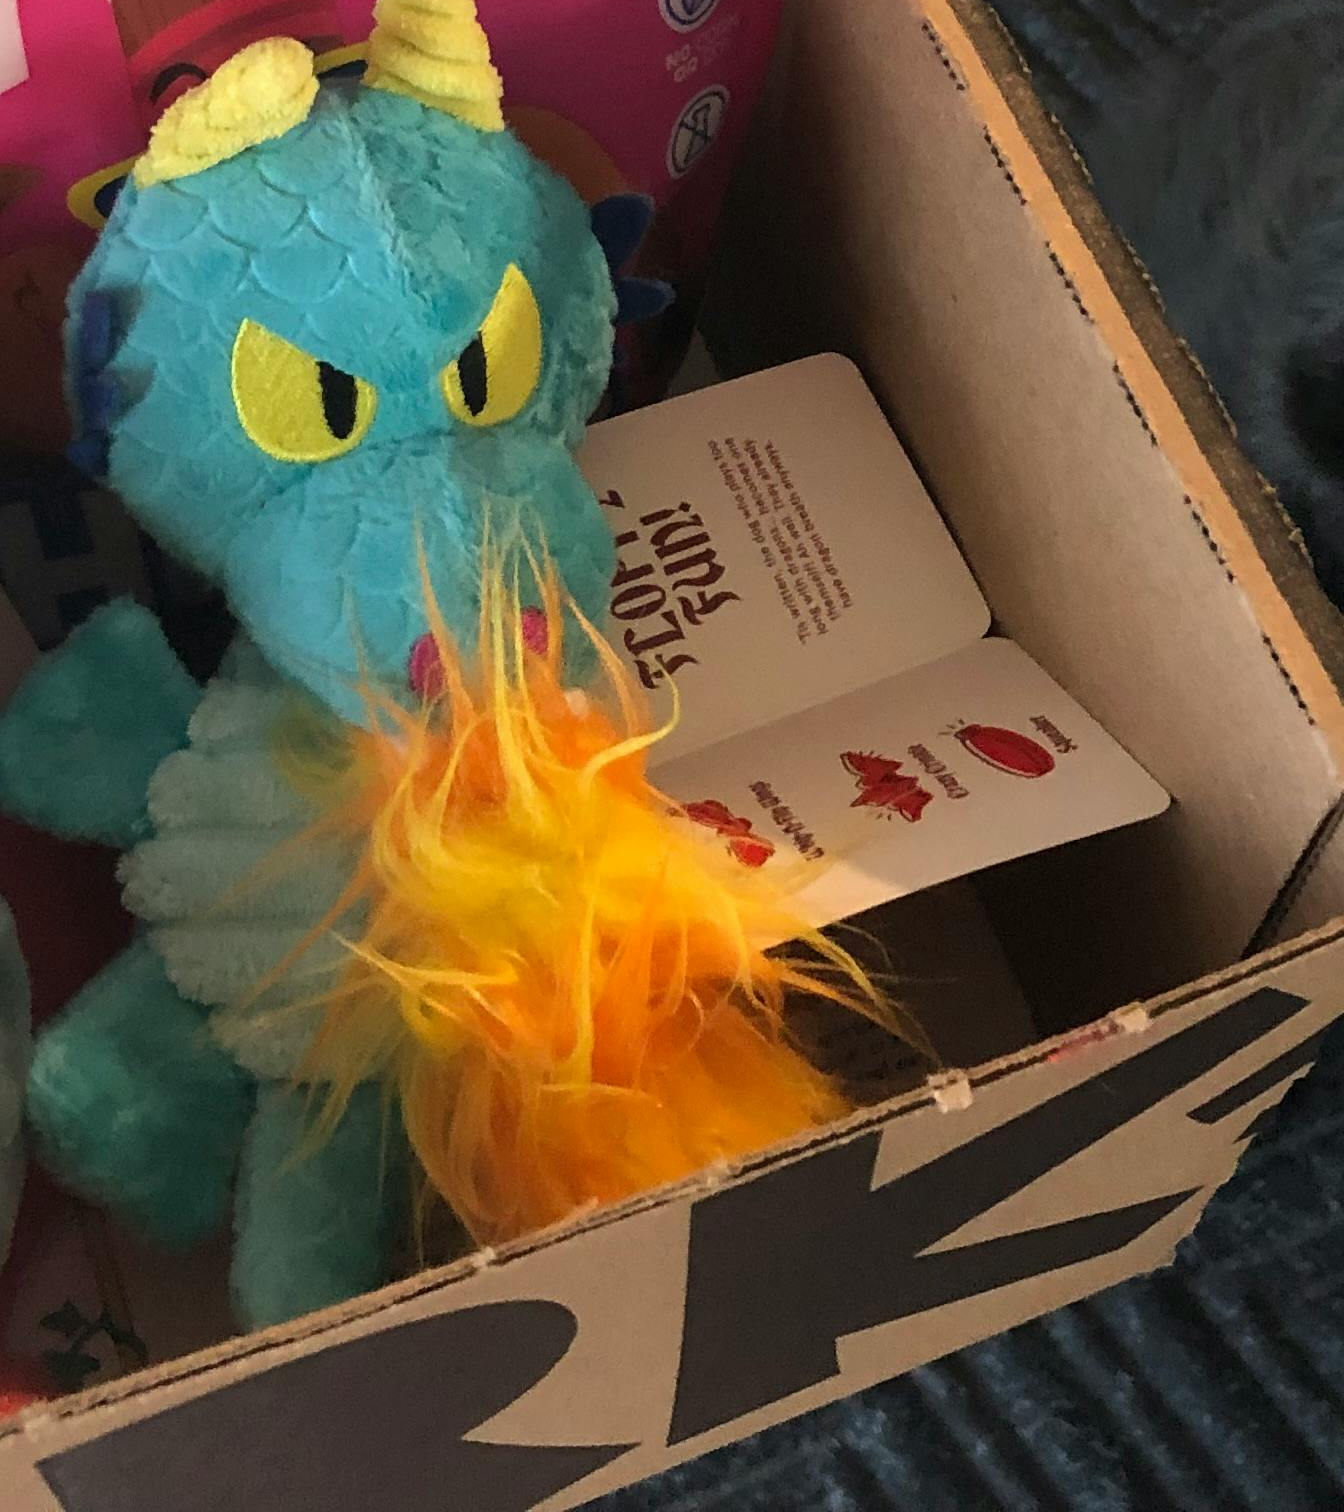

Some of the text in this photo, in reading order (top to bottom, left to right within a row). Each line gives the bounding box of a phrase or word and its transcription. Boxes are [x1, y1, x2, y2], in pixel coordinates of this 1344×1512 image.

[708, 439, 723, 461] too
[743, 439, 771, 482] already
[718, 461, 741, 493] plays
[734, 493, 752, 520] who
[767, 482, 785, 512] They
[788, 490, 816, 533] breath
[748, 519, 766, 544] dog
[640, 500, 742, 627] FUN!
[760, 545, 777, 569] the
[810, 533, 839, 577] dragon
[794, 576, 814, 606] with
[832, 577, 854, 609] have
[809, 605, 830, 636] long
